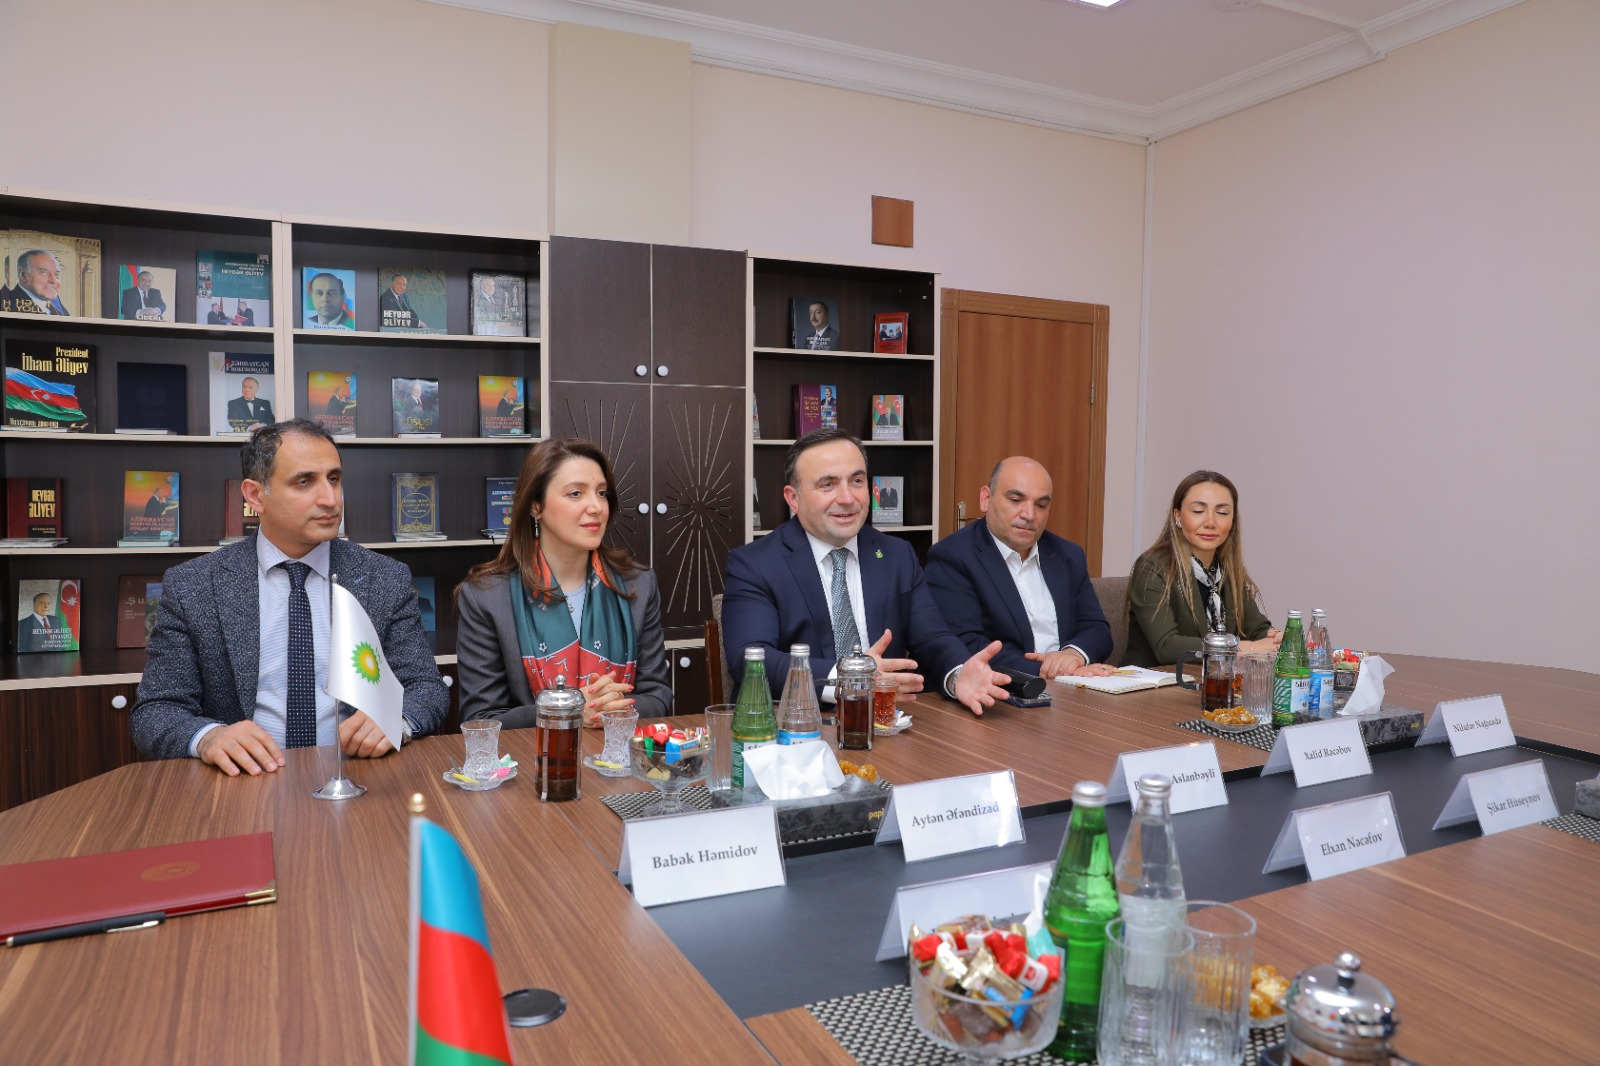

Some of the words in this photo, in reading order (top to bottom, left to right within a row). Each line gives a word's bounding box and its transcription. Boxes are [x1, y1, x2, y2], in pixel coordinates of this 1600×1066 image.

[383, 310, 411, 318] HEYDƏR
[383, 318, 411, 327] ƏLİYEV
[56, 347, 89, 358] Prezident
[22, 353, 52, 371] İlham
[55, 357, 89, 375] Əliyev
[32, 489, 55, 502] HEYDƏR
[29, 502, 56, 518] ƏLİYEV
[1304, 749, 1323, 761] Xalid
[1171, 768, 1216, 784] Aslanbəyli
[1506, 794, 1541, 808] Hüseynov
[911, 811, 944, 829] Aytən
[946, 801, 1001, 821] Əfəndizad
[1320, 842, 1347, 856] Elxan
[1346, 832, 1383, 850] Nəcəfov
[652, 852, 695, 869] Babək
[698, 845, 758, 863] Həmidov
